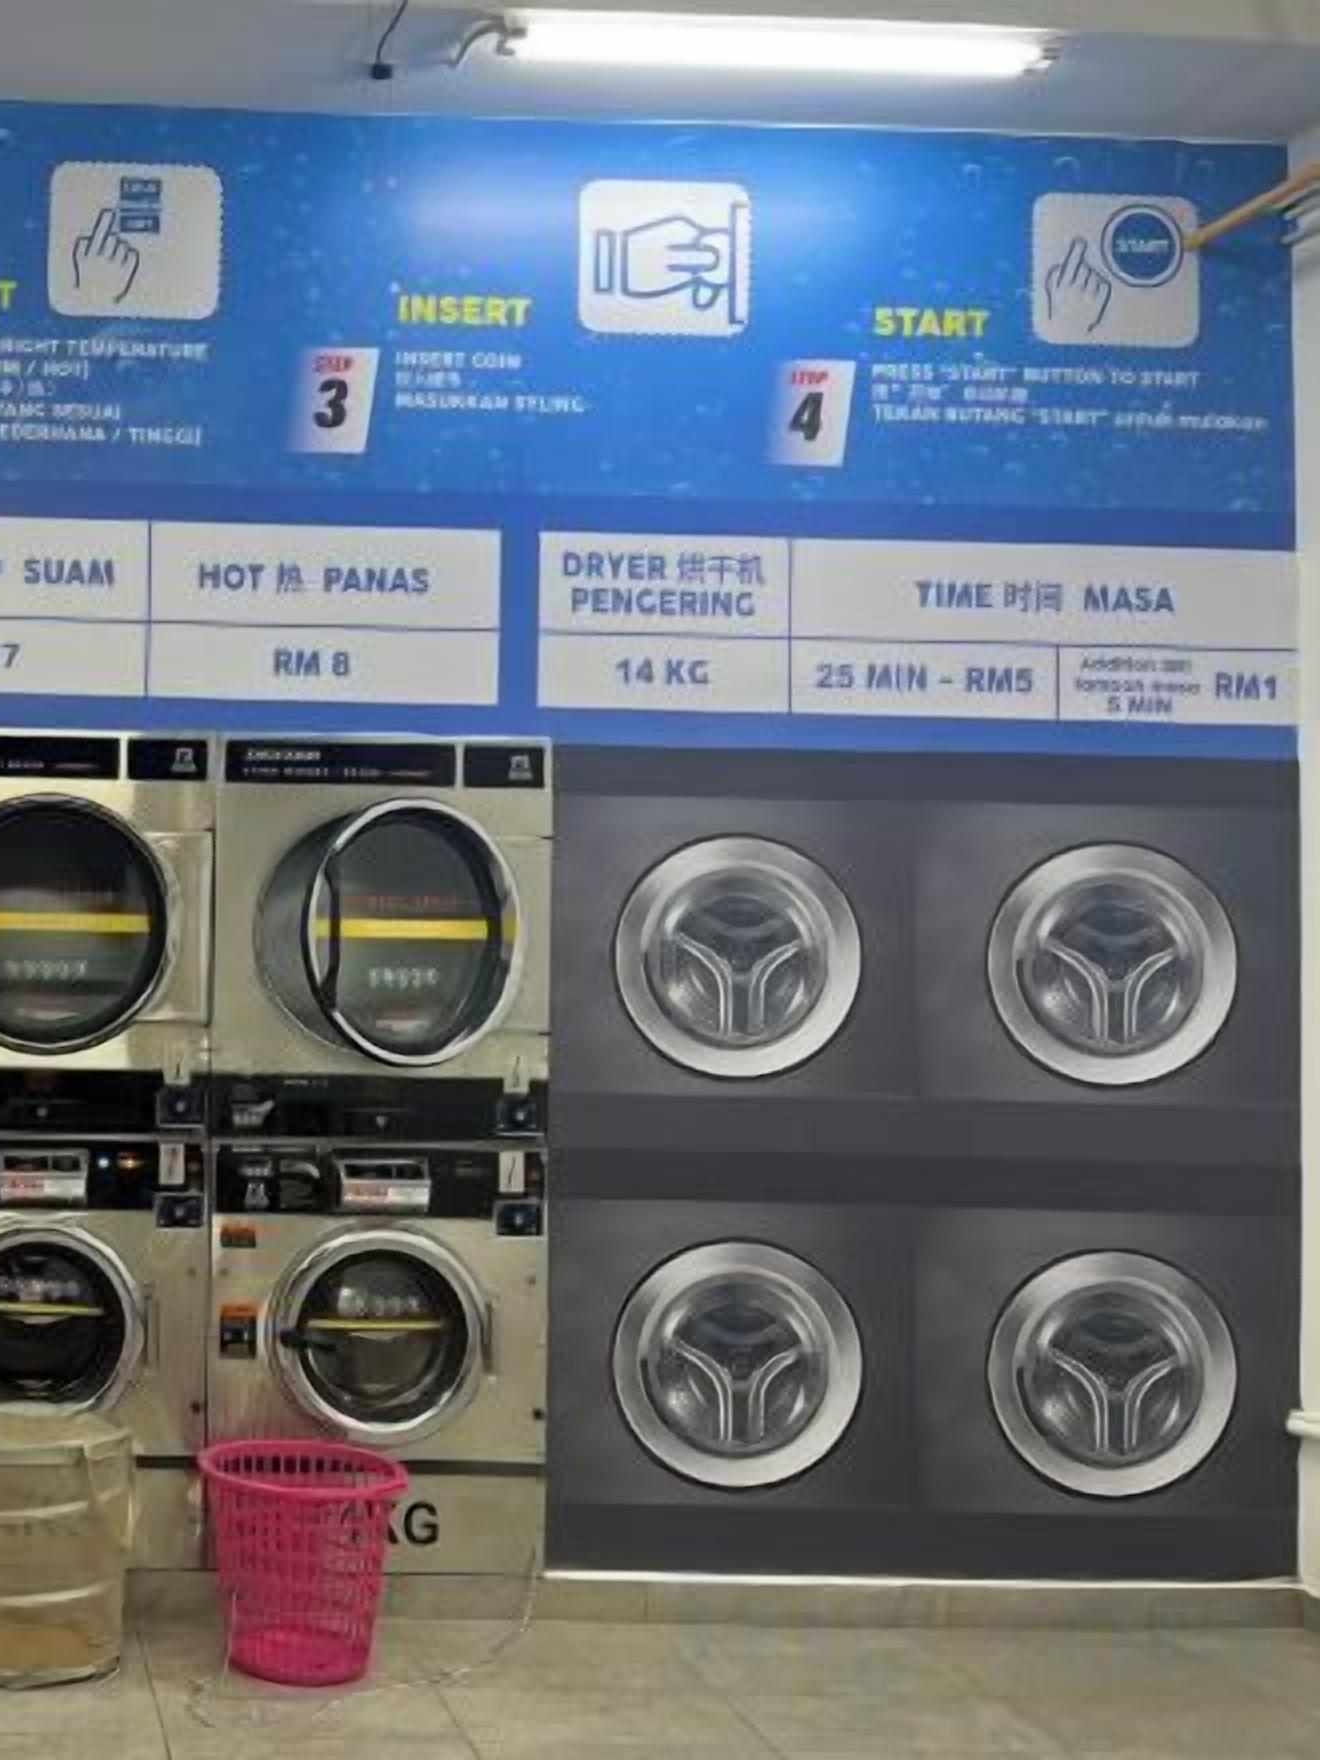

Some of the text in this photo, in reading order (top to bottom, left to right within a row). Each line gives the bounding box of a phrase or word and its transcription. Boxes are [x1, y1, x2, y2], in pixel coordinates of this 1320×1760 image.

[398, 294, 532, 327] INSERT
[872, 307, 991, 338] START
[312, 378, 349, 429] 3
[789, 391, 825, 442] 4
[23, 555, 115, 587] SUAM
[198, 562, 265, 592] HOT
[323, 565, 430, 594] PANAS
[561, 550, 668, 582] DRYER
[569, 587, 757, 617] PENGERING
[915, 580, 1176, 614] TIME 时间 MASA
[1, 642, 21, 669] 7
[273, 649, 350, 677] RM 8
[615, 658, 710, 686] 14 KG
[816, 663, 855, 690] 25
[866, 663, 928, 693] MIN
[964, 665, 1035, 694] RM5
[1214, 671, 1278, 701] RM1
